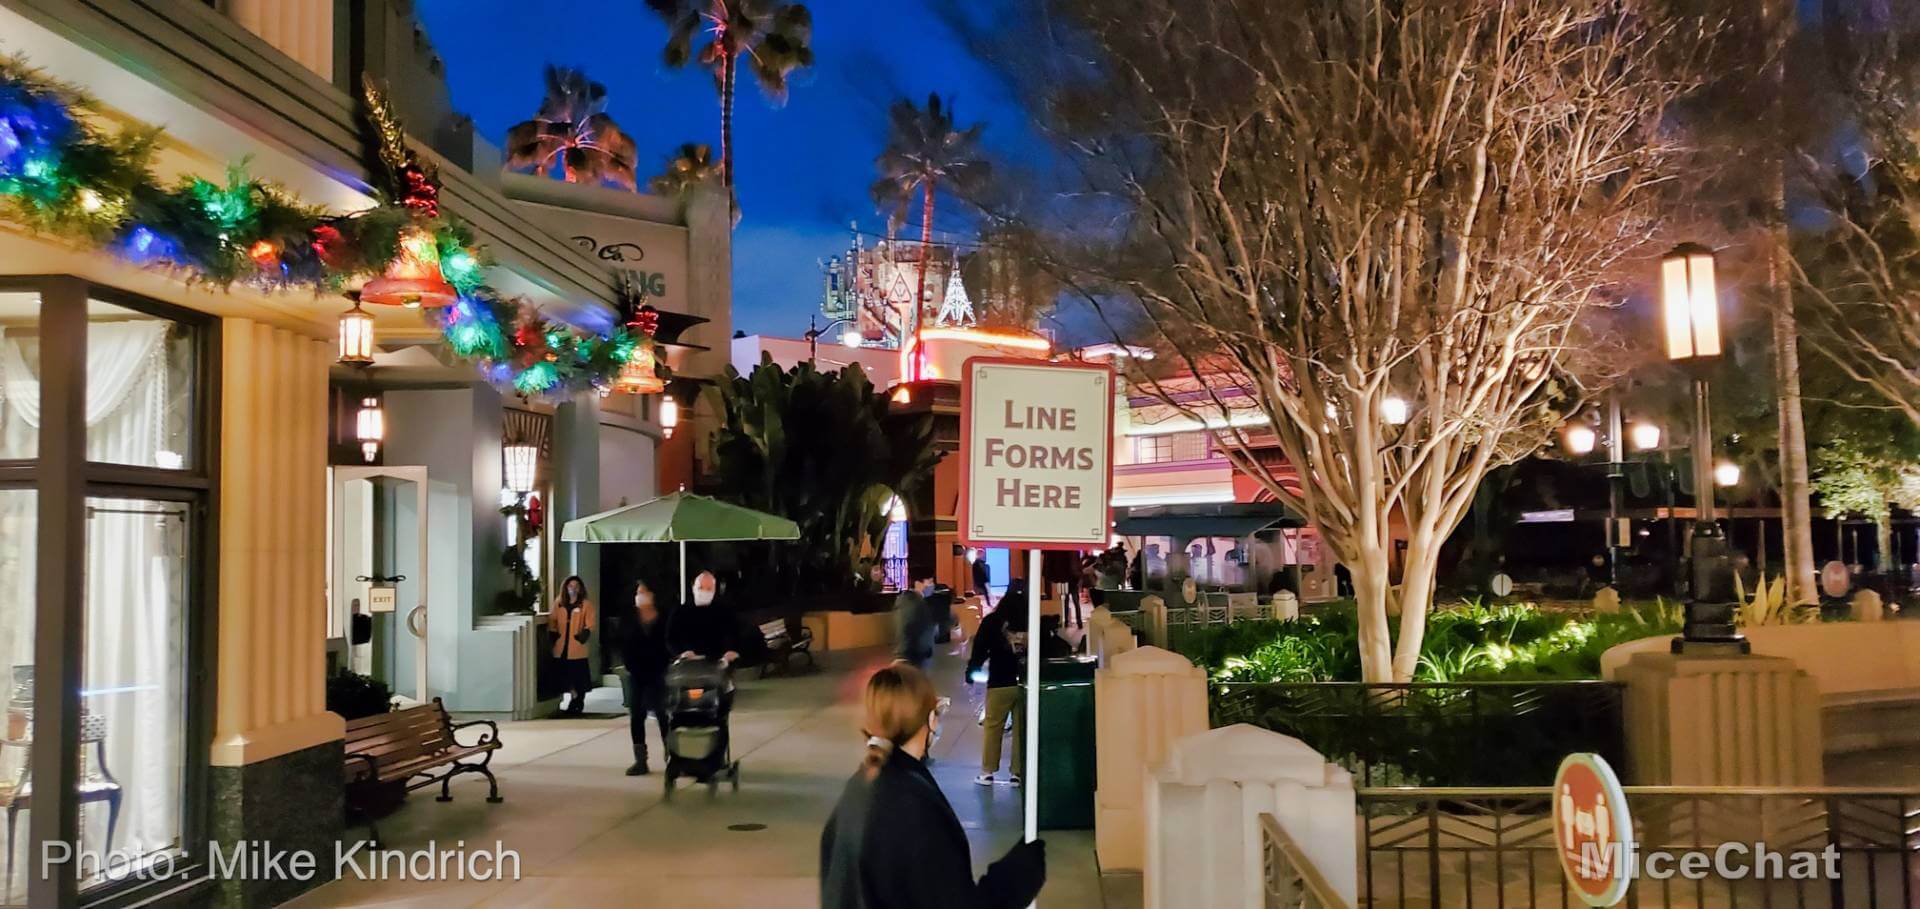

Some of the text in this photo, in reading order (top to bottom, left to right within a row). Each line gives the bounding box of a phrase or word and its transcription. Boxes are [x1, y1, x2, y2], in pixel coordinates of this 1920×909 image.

[1004, 399, 1076, 431] LINE
[984, 438, 1094, 470] FORMS
[996, 478, 1081, 509] HERE
